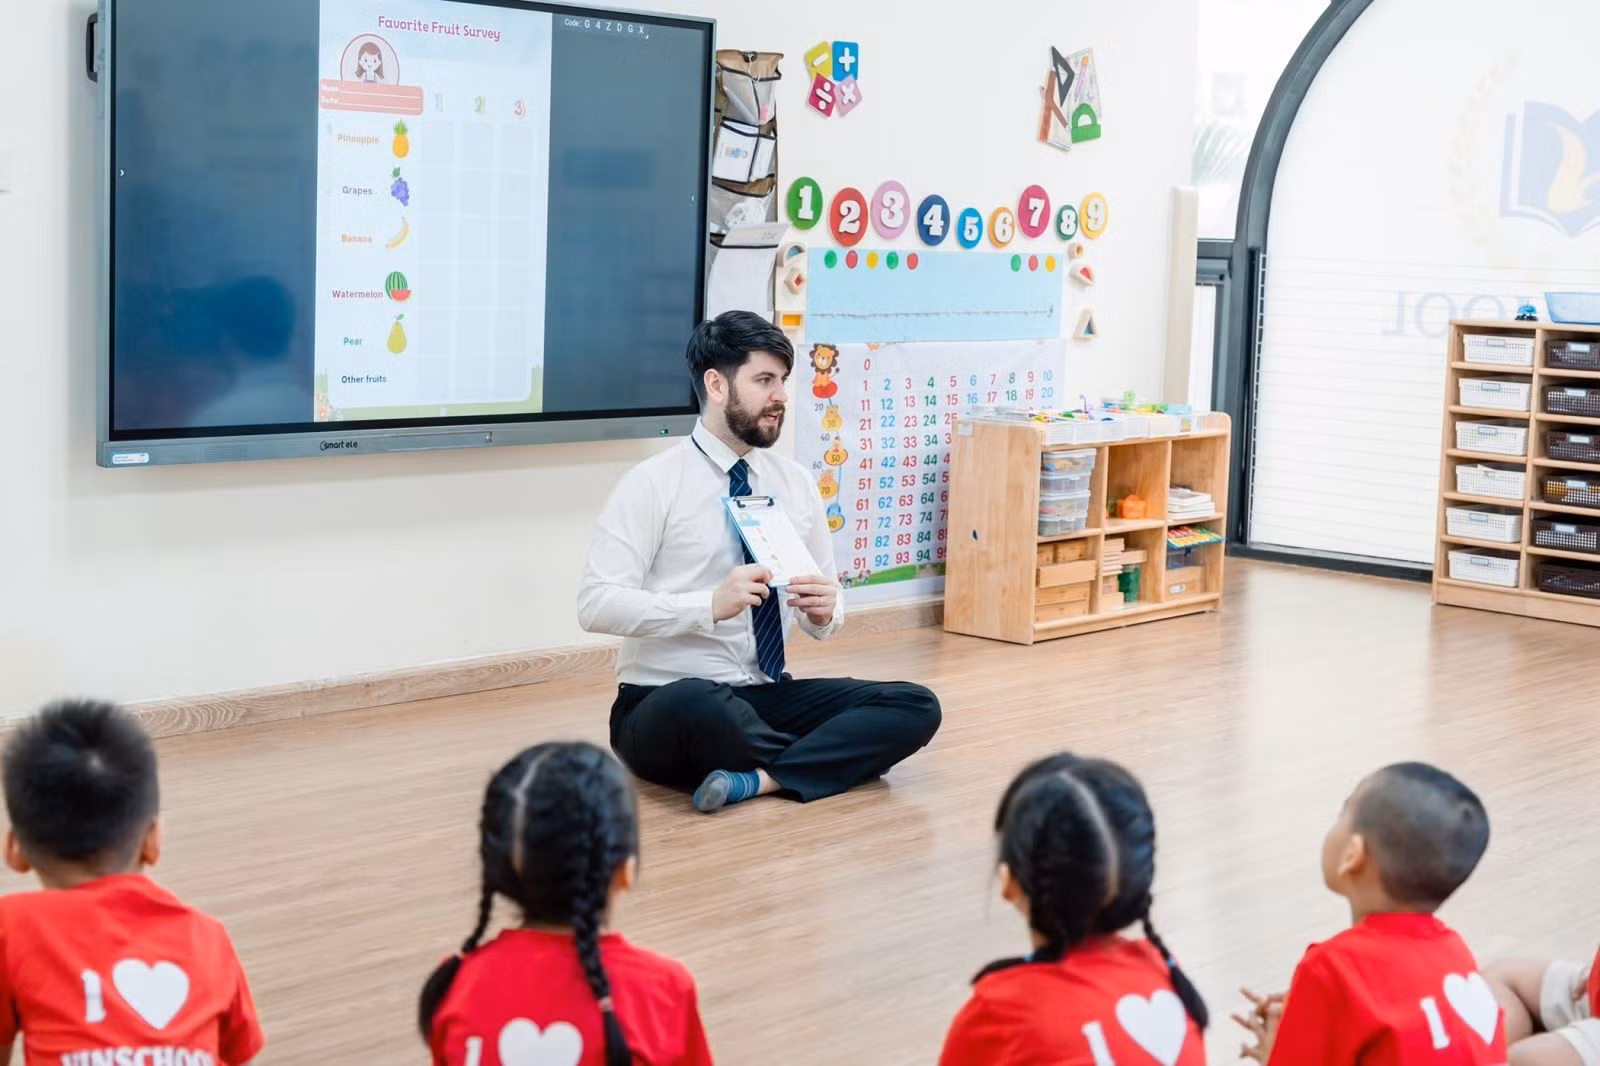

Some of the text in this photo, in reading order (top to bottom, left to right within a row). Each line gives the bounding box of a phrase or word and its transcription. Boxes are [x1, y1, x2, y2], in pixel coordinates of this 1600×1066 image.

[378, 16, 501, 42] Favorite Fruit Survey
[584, 20, 590, 28] G
[606, 22, 612, 31] Z
[617, 23, 622, 32] D
[628, 25, 634, 33] G
[474, 96, 485, 113] 2
[513, 99, 526, 117] 3
[337, 133, 380, 145] Pineapple
[342, 186, 373, 196] Grapes
[798, 185, 1104, 243] 1 2 3 4 5 6 7 8 9
[341, 233, 373, 243] Banana
[332, 290, 383, 299] Watermelon
[343, 337, 362, 345] Pear
[864, 358, 871, 371] 0
[341, 375, 387, 384] Other fruits
[863, 380, 868, 391] 1
[884, 378, 891, 390] 2
[905, 377, 911, 390] 3
[928, 377, 934, 388] 4
[950, 376, 957, 387] 5
[970, 375, 976, 386] 6
[991, 374, 996, 385] 7
[1009, 372, 1015, 384] 8
[1028, 371, 1034, 383] 9
[861, 387, 1053, 411] 11 12 13 14 15 16 17 18 19 20
[860, 418, 871, 430] 21
[881, 415, 895, 427] 22
[904, 416, 917, 428] 23
[924, 414, 936, 426] 24
[860, 438, 872, 450] 31
[881, 437, 895, 449] 32
[904, 436, 917, 448] 33
[925, 434, 938, 446] 34
[813, 461, 822, 469] 60
[832, 454, 840, 462] 50
[860, 458, 872, 470] 41
[881, 456, 896, 468] 42
[903, 456, 917, 467] 43
[924, 454, 937, 466] 44
[859, 478, 871, 490] 51
[880, 476, 894, 489] 52
[902, 474, 915, 487] 53
[922, 473, 936, 485] 54
[821, 486, 830, 494] 70
[856, 498, 869, 511] 61
[878, 496, 892, 509] 62
[899, 494, 913, 506] 63
[920, 492, 934, 504] 64
[856, 519, 868, 531] 71
[878, 516, 891, 528] 72
[899, 513, 912, 526] 73
[919, 512, 933, 524] 74
[855, 537, 867, 550] 81
[875, 535, 889, 547] 82
[897, 533, 911, 546] 83
[917, 530, 931, 543] 84
[854, 557, 867, 570] 91
[875, 554, 889, 567] 92
[896, 551, 910, 564] 93
[916, 549, 931, 562] 94
[81, 968, 106, 1023] I
[1420, 996, 1450, 1049] I
[1081, 1021, 1116, 1066] I
